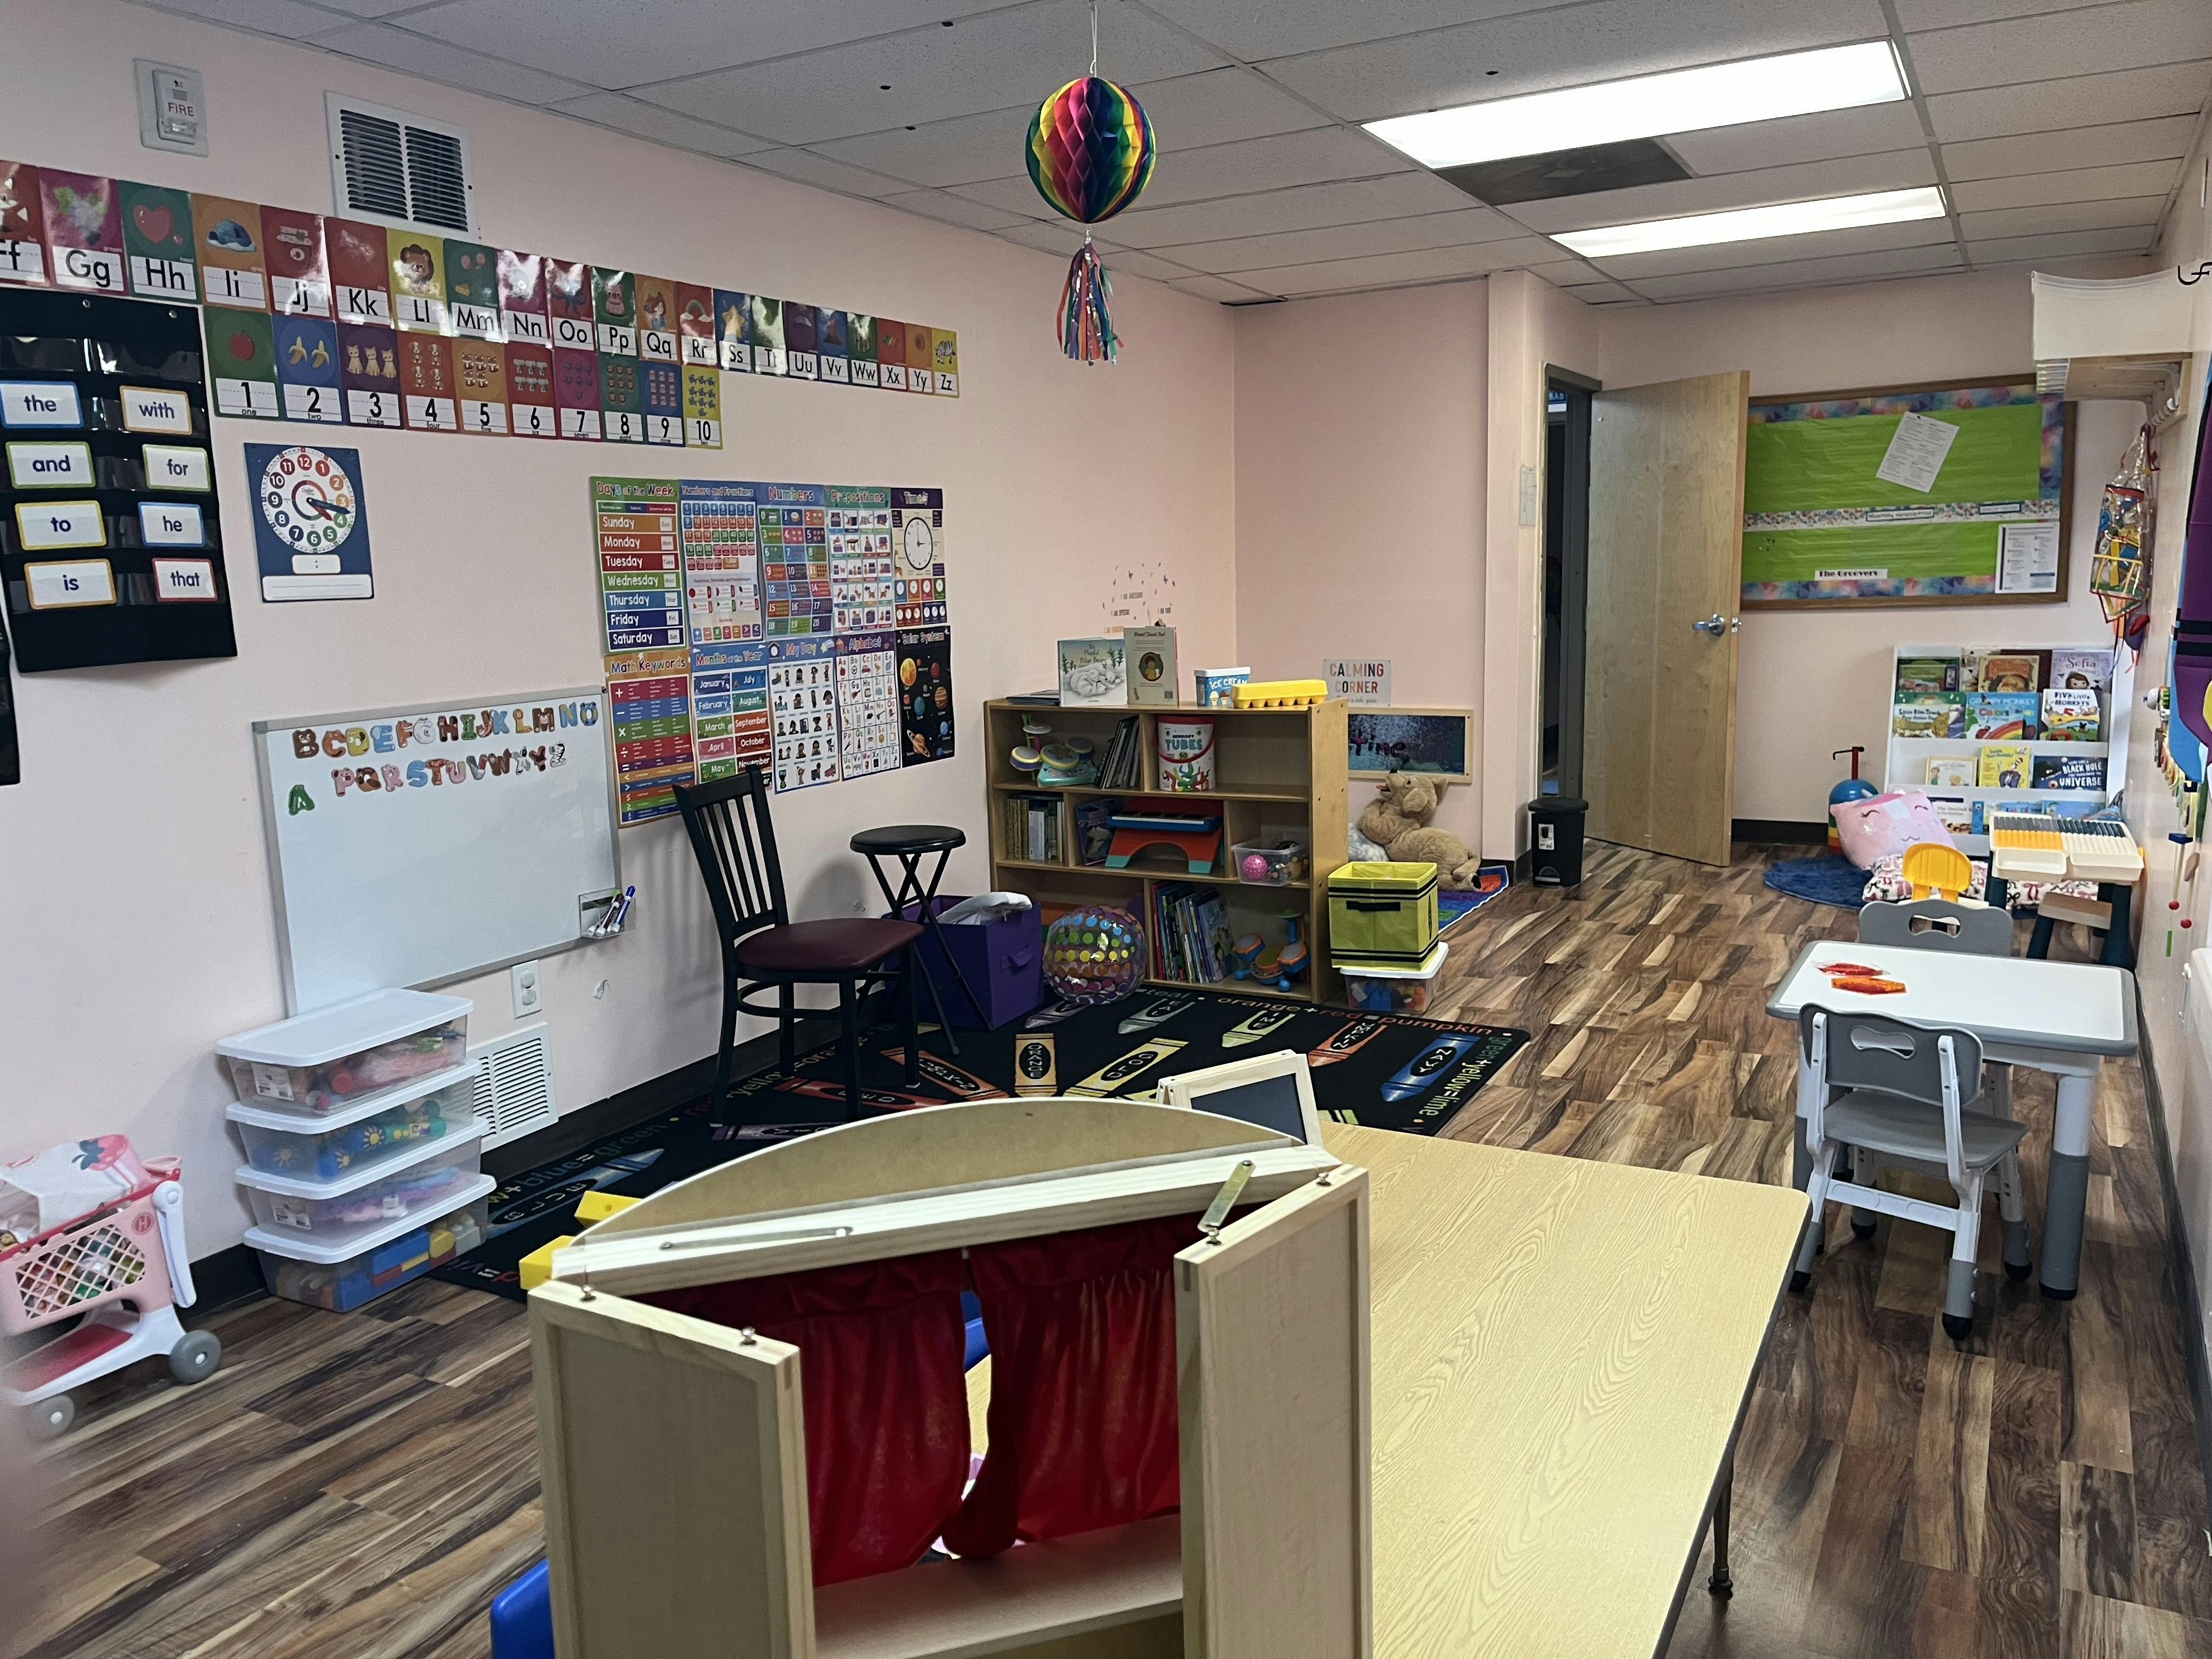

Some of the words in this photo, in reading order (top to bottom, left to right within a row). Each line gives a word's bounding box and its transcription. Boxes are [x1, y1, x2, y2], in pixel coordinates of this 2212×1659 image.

[168, 102, 194, 117] FIRE
[66, 250, 110, 287] Gg
[145, 258, 185, 290] Hh
[225, 269, 240, 298] Ii
[292, 280, 309, 312] Jj
[348, 288, 379, 317] Kk
[414, 298, 430, 324] Ll
[457, 306, 493, 330] Mm
[514, 313, 541, 337] Nn
[559, 319, 588, 344] Oo
[610, 326, 629, 354] Pp
[646, 331, 672, 359] Qq
[692, 338, 707, 358] Rr
[729, 346, 743, 363] Ss
[794, 353, 812, 373] Uu
[827, 359, 842, 376] Vv
[854, 363, 876, 381] Ww
[886, 366, 900, 384] Xx
[915, 369, 927, 392] Yy
[941, 374, 952, 391] Zz
[241, 381, 251, 408] 1
[307, 387, 321, 413] 2
[24, 395, 56, 412] the
[139, 402, 174, 419] with
[369, 393, 382, 418] 3
[425, 398, 437, 422] 4
[479, 403, 490, 426] 5
[530, 407, 540, 430] 6
[576, 410, 585, 432] 7
[620, 414, 629, 435] 8
[661, 417, 669, 438] 9
[696, 420, 711, 441] 10
[32, 455, 71, 472] and
[167, 459, 188, 476] for
[283, 461, 292, 472] 11
[298, 458, 310, 467] 12
[320, 464, 325, 473] 1
[271, 475, 284, 486] 10
[334, 478, 340, 487] 2
[597, 482, 621, 497] Days
[623, 486, 631, 495] of
[633, 486, 645, 495] the
[646, 483, 674, 497] Week
[769, 486, 814, 501] Numbers
[831, 489, 884, 504] Prepositions
[271, 495, 279, 505] 9
[340, 497, 347, 506] 3
[163, 516, 183, 532] he
[279, 514, 285, 524] 8
[337, 516, 343, 524] 4
[603, 517, 635, 529] Sunday
[806, 512, 810, 521] 2
[50, 517, 71, 532] to
[293, 529, 299, 538] 7
[311, 534, 317, 544] 6
[327, 530, 333, 538] 5
[763, 530, 768, 539] 3
[807, 530, 811, 538] 5
[605, 535, 640, 549] Monday
[765, 548, 769, 556] 6
[809, 548, 813, 556] 8
[606, 555, 642, 568] Tuesday
[766, 566, 771, 575] 9
[788, 566, 795, 575] 10
[63, 574, 79, 591] is
[171, 571, 200, 587] that
[607, 574, 658, 587] Wednesday
[768, 585, 776, 593] 12
[609, 594, 650, 607] Thursday
[769, 603, 775, 612] 15
[792, 602, 798, 611] 16
[814, 601, 820, 610] 17
[611, 613, 639, 626] Friday
[812, 618, 820, 627] 20
[613, 632, 652, 645] Saturday
[849, 636, 882, 652] Alphabet
[786, 643, 799, 657] My
[800, 642, 816, 656] Day
[611, 661, 637, 674] Math
[639, 657, 686, 673] Keywords
[696, 653, 727, 666] Months
[743, 651, 763, 662] Year
[1329, 663, 1384, 677] CALMING
[700, 680, 725, 688] January
[743, 675, 755, 684] July
[1209, 680, 1222, 690] ICE
[1335, 680, 1378, 694] CORNER
[699, 701, 727, 710] February
[740, 696, 759, 706] August
[705, 722, 725, 731] March
[735, 717, 766, 728] September
[708, 742, 724, 753] April
[741, 737, 765, 747] October
[1165, 738, 1203, 751] TUBES
[712, 765, 725, 773] May
[738, 758, 770, 768] November
[2062, 764, 2084, 774] BLACK
[2085, 762, 2102, 771] HOLE
[2059, 777, 2101, 787] UNIVERSE
[288, 785, 315, 816] A
[1218, 997, 1301, 1012] orange
[1319, 1009, 1363, 1019] red
[1379, 1017, 1492, 1035] pumpkin
[1481, 1036, 1514, 1060] green
[1028, 1045, 1042, 1077] ORANGE
[1107, 1053, 1153, 1079] GOLD
[1419, 1048, 1452, 1073] NAVY
[1444, 1062, 1487, 1091] yellow
[1419, 1095, 1460, 1116] lime
[516, 1153, 583, 1187] blue
[594, 1125, 669, 1156] green
[504, 1183, 587, 1221] BLUE
